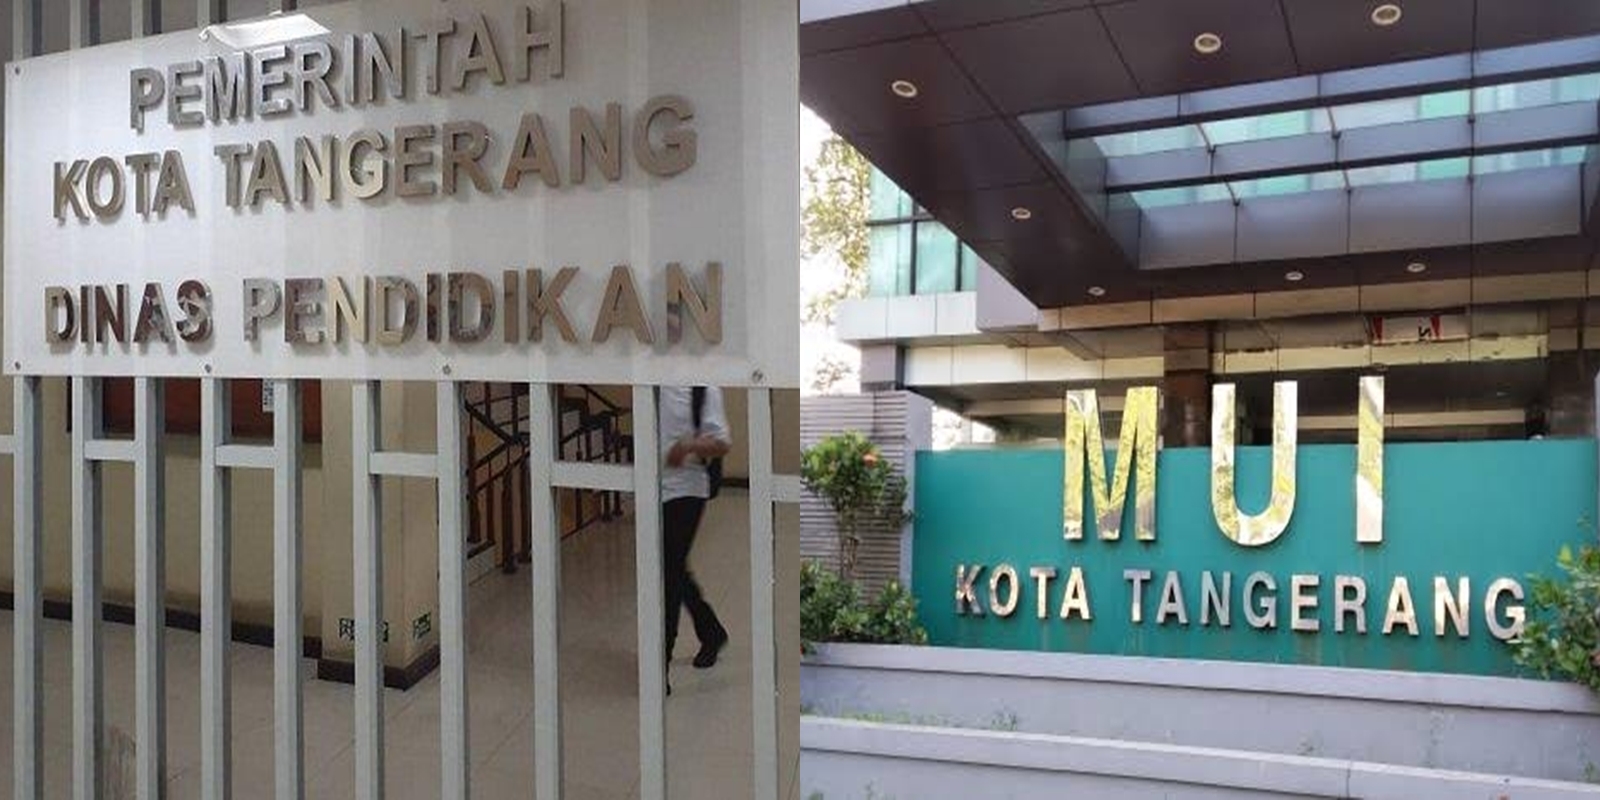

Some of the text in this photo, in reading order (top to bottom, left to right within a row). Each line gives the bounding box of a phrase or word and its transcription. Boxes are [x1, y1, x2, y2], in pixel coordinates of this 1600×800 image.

[129, 0, 565, 132] PEMERINTAH
[51, 94, 697, 223] KOTA TANGERANG
[44, 261, 724, 346] DINAS PENDIDIKAN
[1063, 375, 1385, 546] MUI
[955, 563, 1526, 641] KOTA TANGERANG
